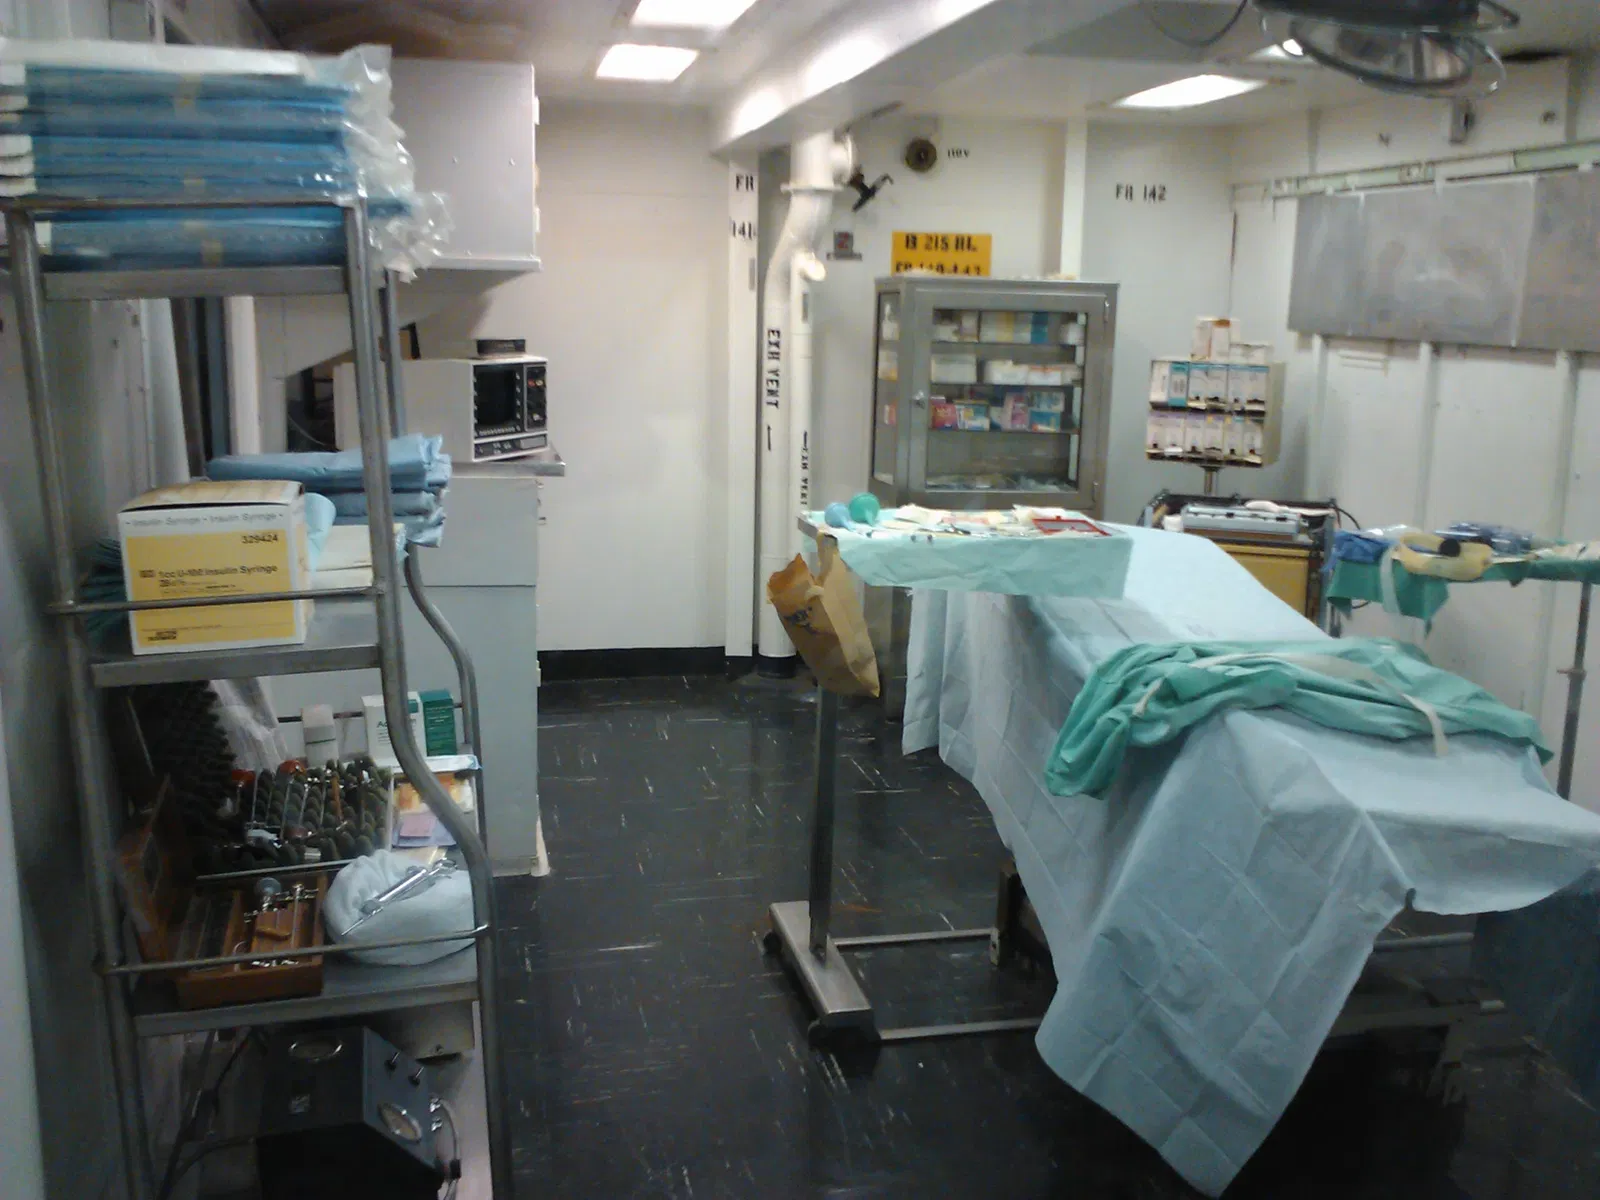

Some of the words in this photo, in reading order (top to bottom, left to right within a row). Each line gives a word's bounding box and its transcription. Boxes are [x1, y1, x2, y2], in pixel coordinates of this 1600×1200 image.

[736, 174, 754, 191] FR
[1116, 183, 1133, 201] FR
[1143, 183, 1166, 202] 142
[767, 329, 781, 360] EXH
[766, 368, 780, 409] VENT
[242, 512, 277, 522] Syringe
[241, 534, 279, 545] 329424
[240, 565, 278, 575] Syringe
